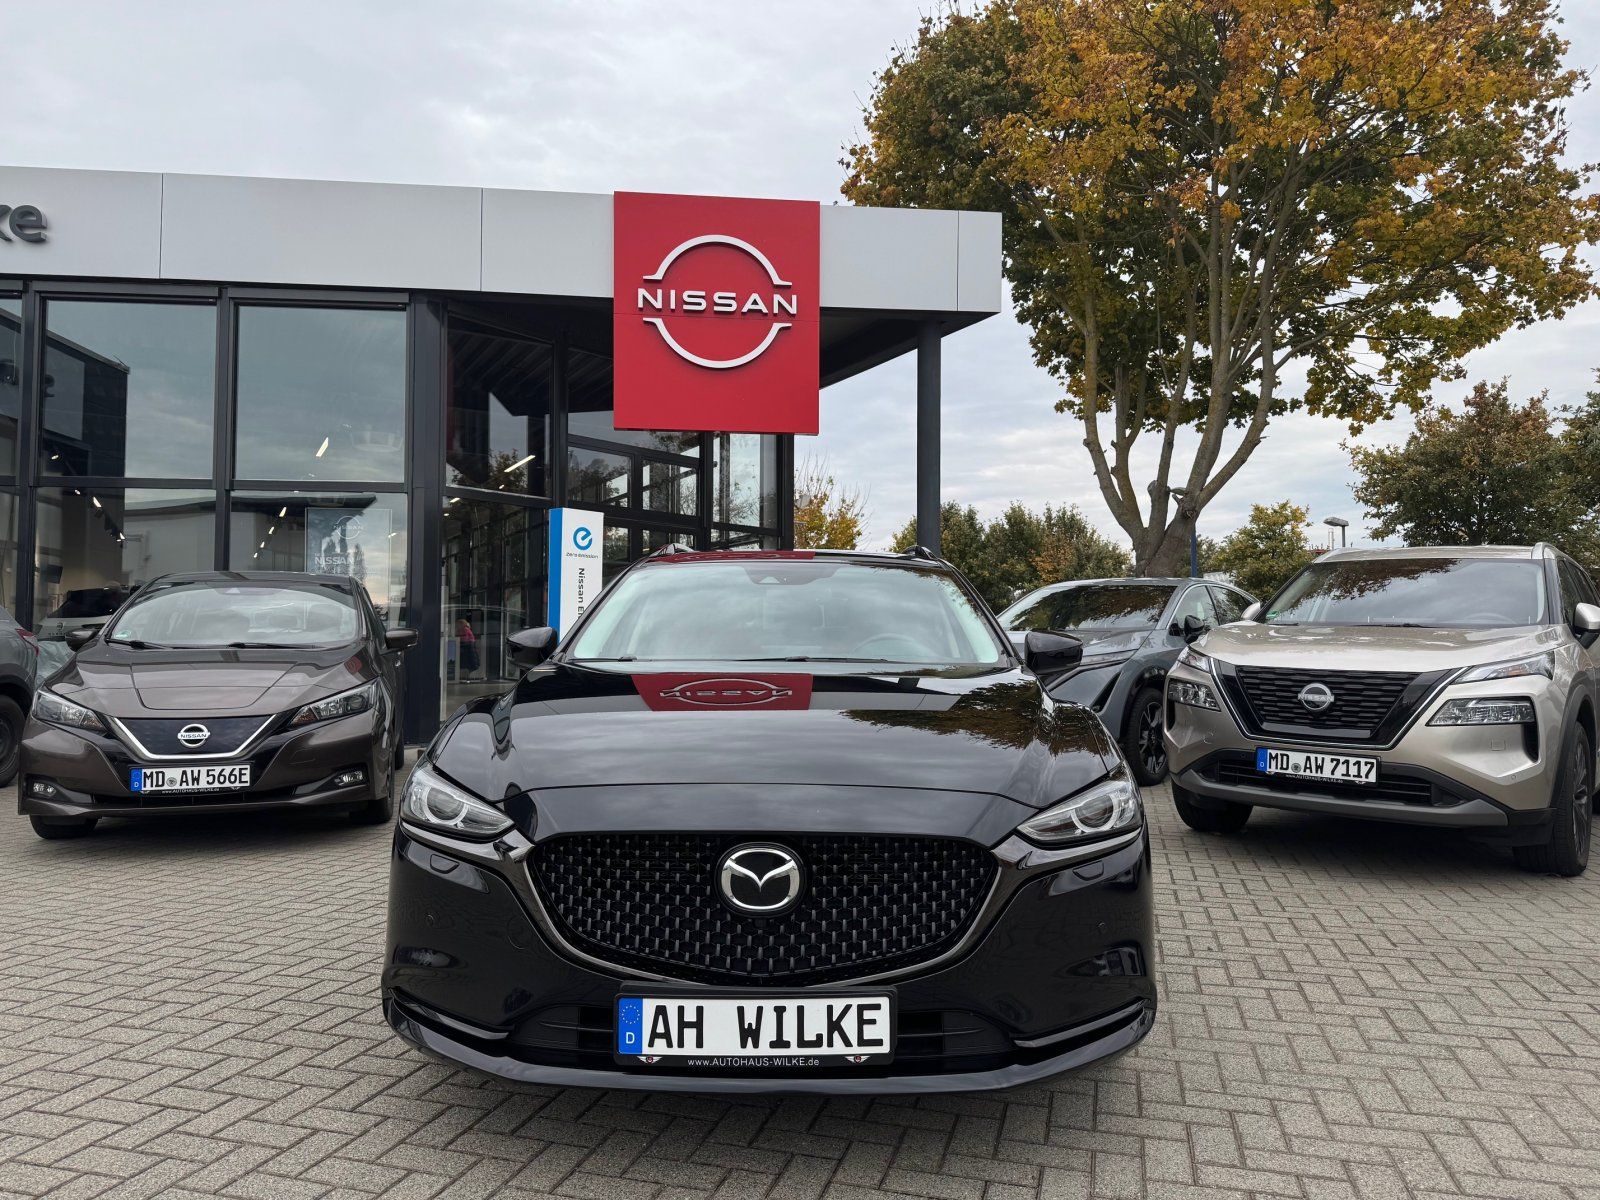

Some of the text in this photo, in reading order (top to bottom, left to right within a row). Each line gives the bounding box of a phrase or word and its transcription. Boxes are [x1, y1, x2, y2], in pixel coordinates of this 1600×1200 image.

[637, 287, 798, 316] NISSAN
[314, 556, 354, 565] NISSAN
[578, 567, 586, 604] Nissan
[1298, 693, 1335, 702] NISSAN
[1268, 751, 1375, 780] MD AW 7117
[143, 767, 249, 789] MD AW 566E
[625, 1031, 635, 1044] D
[648, 1003, 884, 1050] AH WILKE
[687, 1057, 820, 1067] www.AUTOHAUS-WILKE.de
